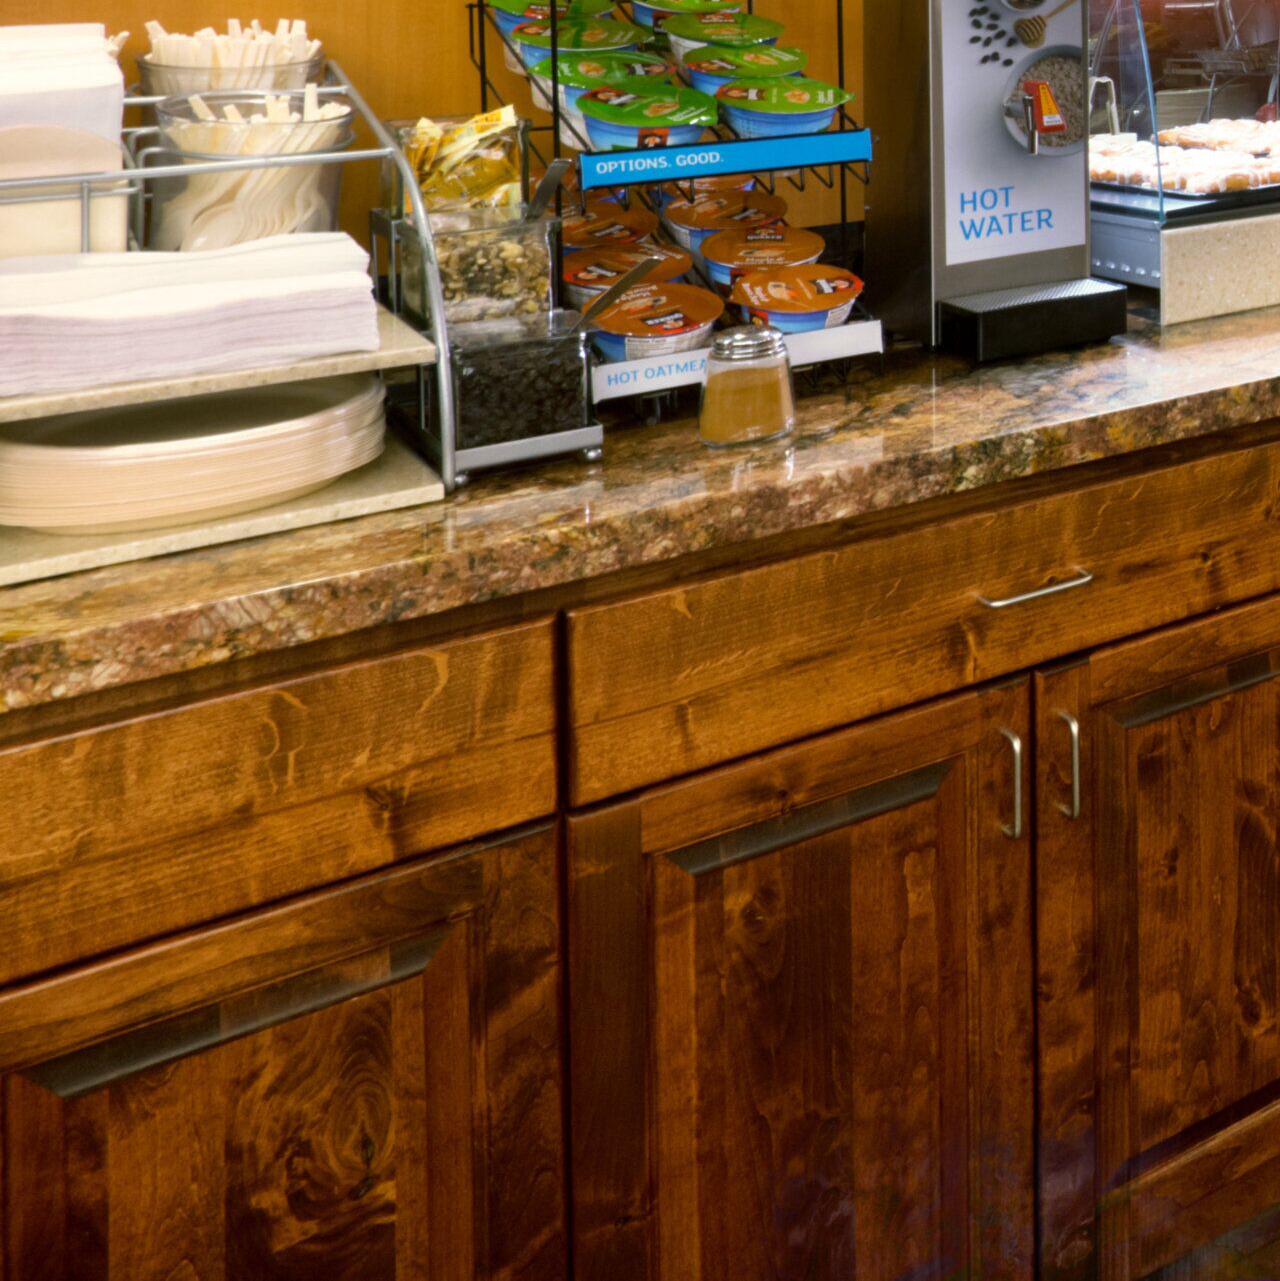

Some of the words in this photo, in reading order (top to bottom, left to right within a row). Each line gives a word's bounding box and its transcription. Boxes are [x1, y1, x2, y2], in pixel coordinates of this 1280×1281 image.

[596, 156, 672, 174] OPTIONS.
[675, 151, 725, 167] GOOD.
[959, 186, 1015, 213] HOT
[959, 208, 1054, 240] WATER
[607, 370, 639, 386] HOT
[644, 359, 707, 379] OATMEA
